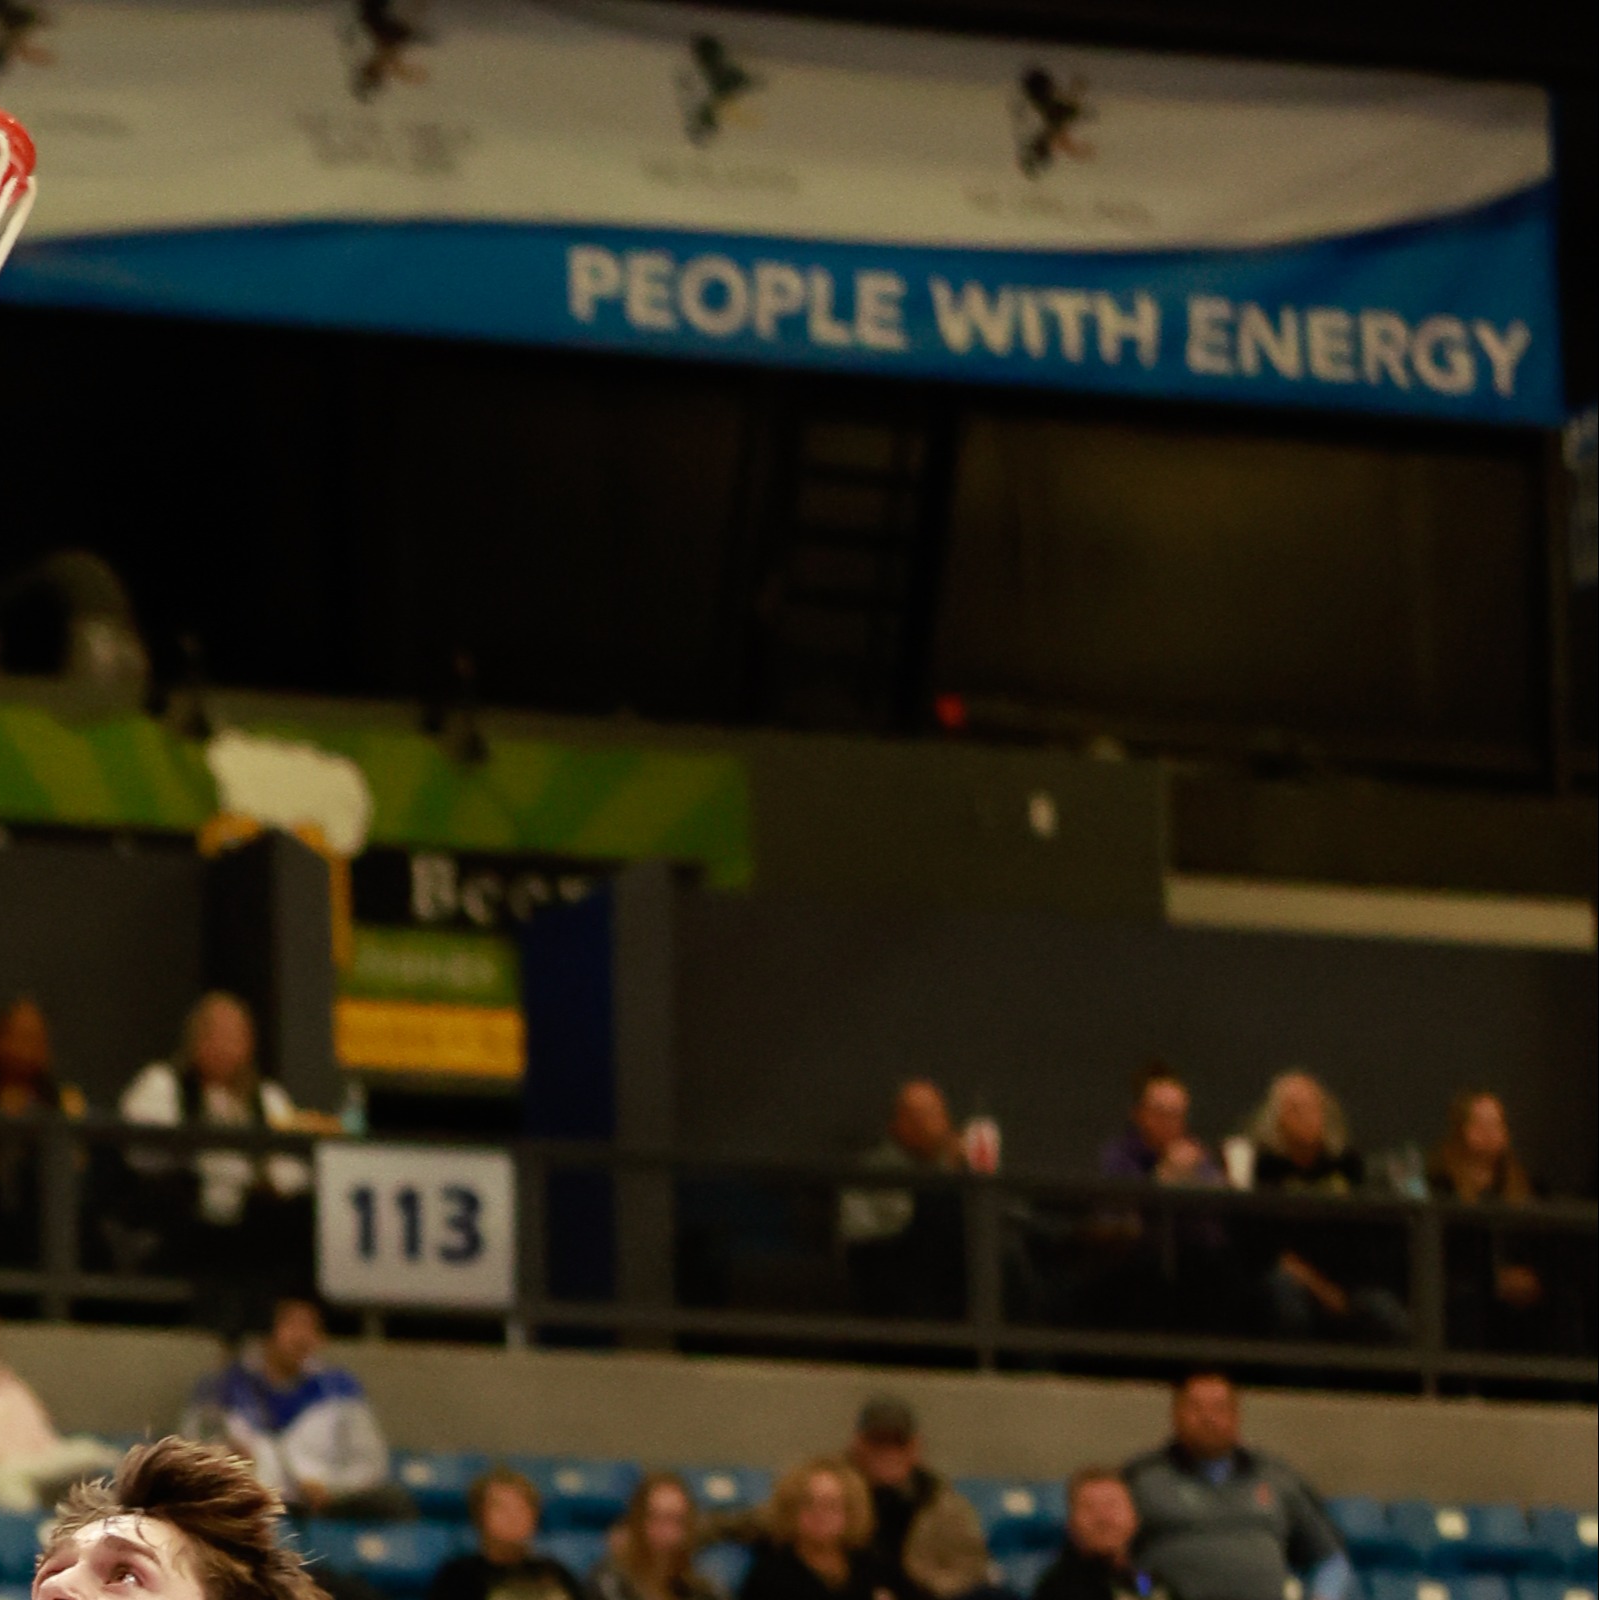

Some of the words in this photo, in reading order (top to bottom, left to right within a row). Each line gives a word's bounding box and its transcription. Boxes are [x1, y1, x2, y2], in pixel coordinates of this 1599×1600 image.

[566, 243, 908, 354] PEOPLE
[929, 275, 1160, 370] WITH
[1184, 292, 1532, 397] ENERGY
[349, 1183, 485, 1267] 113
